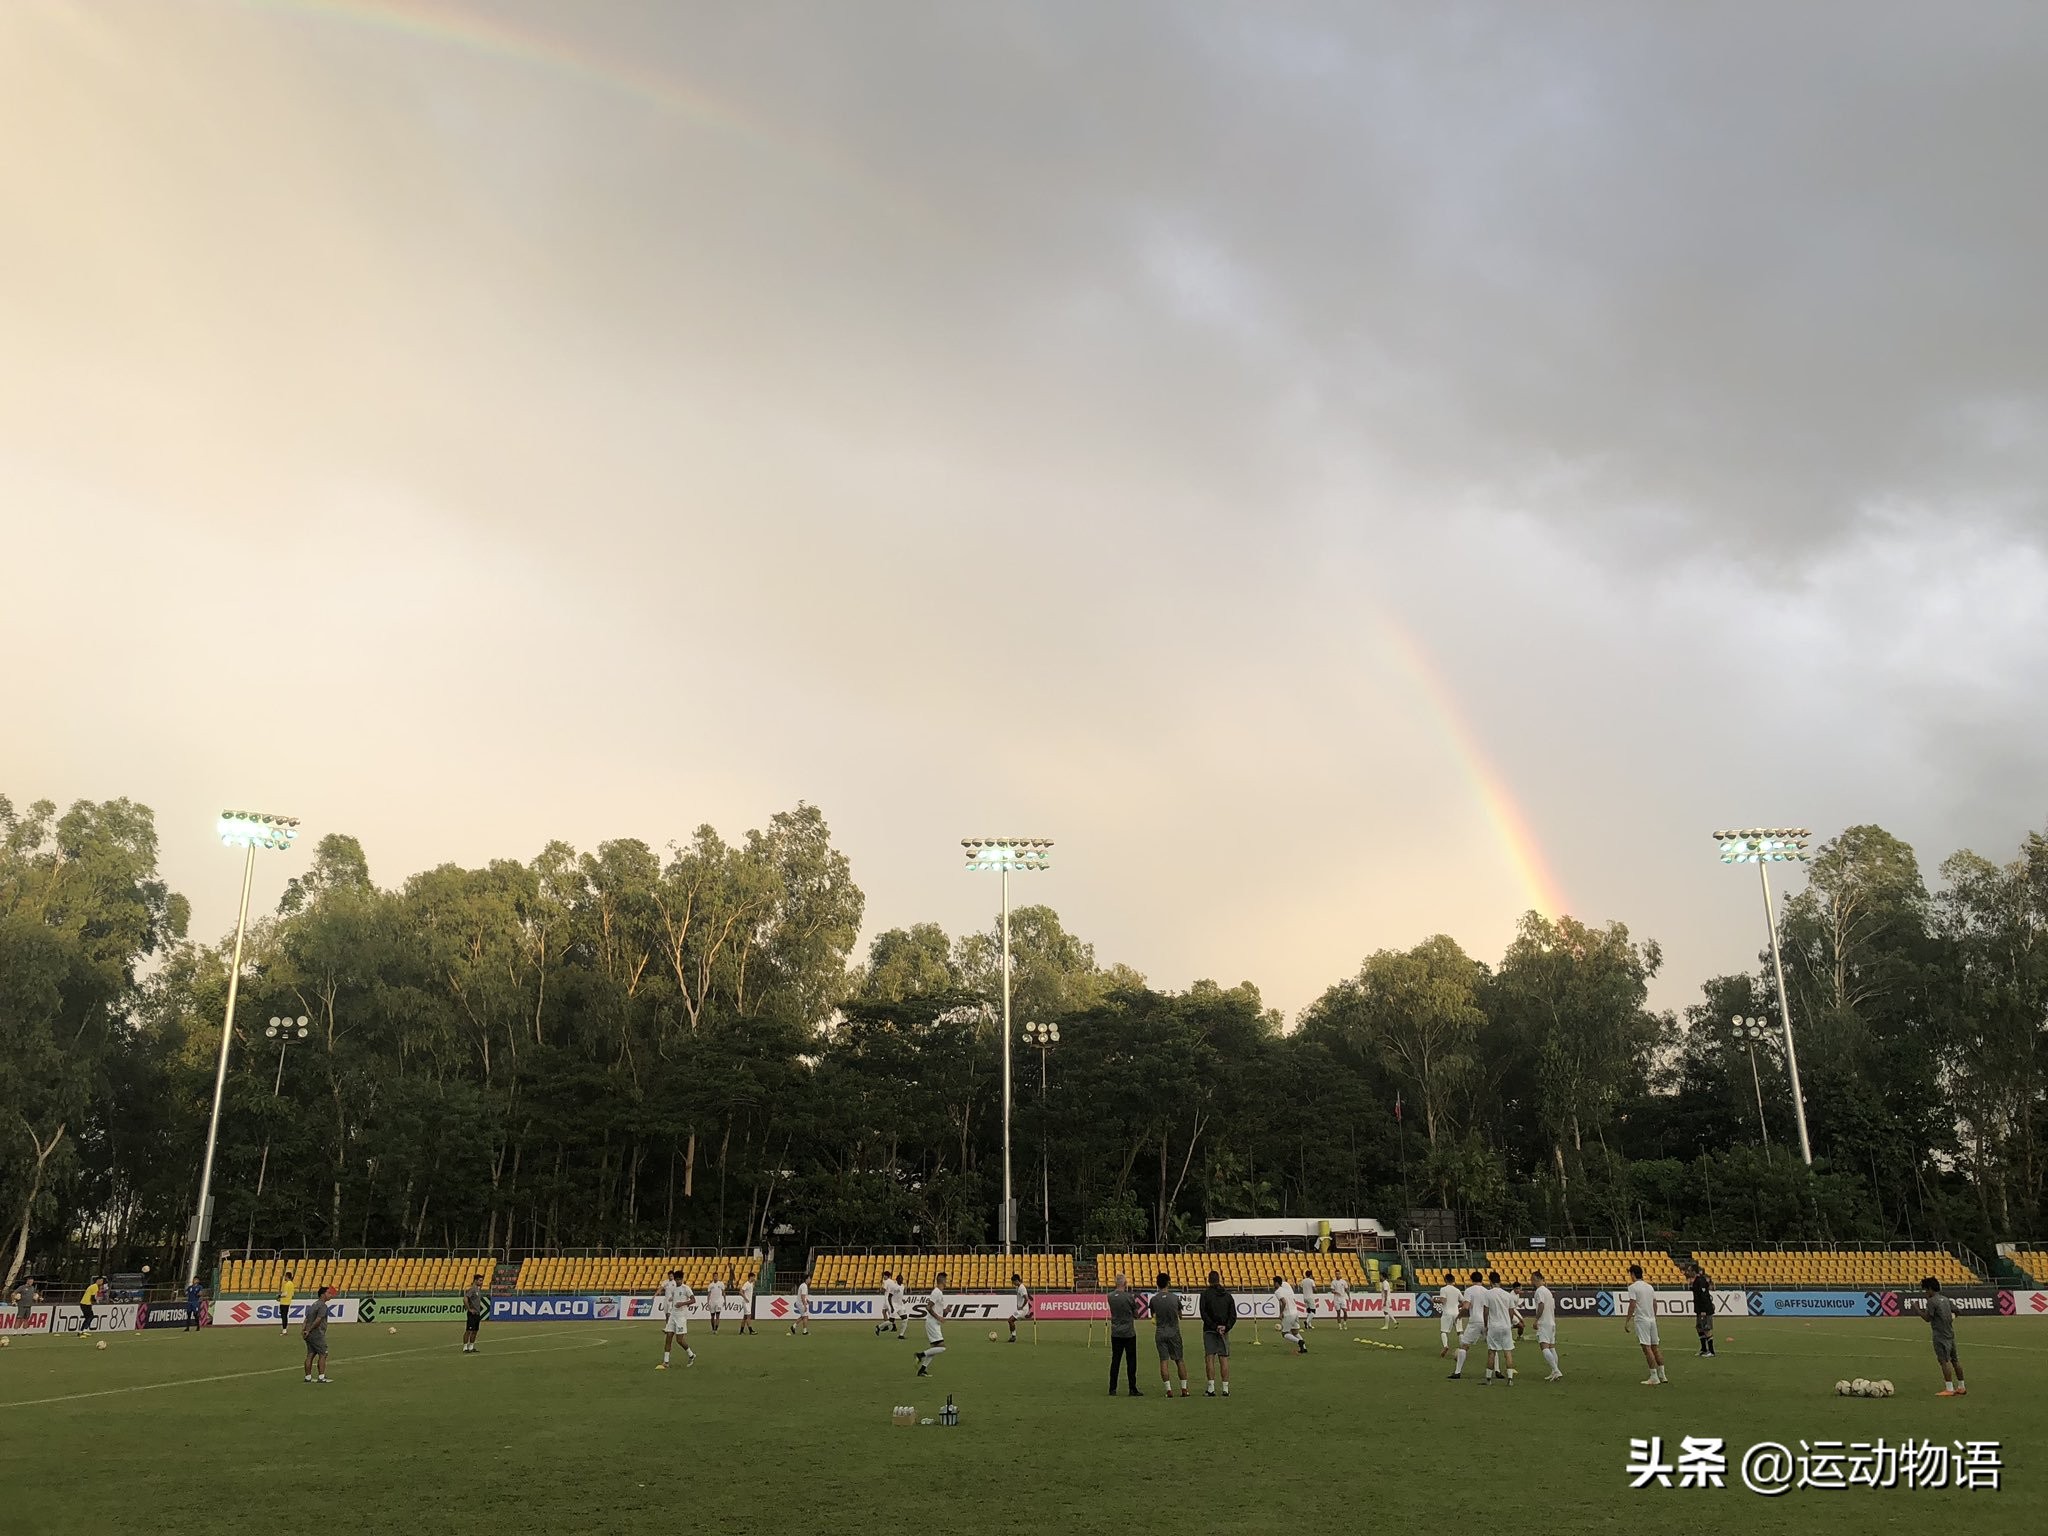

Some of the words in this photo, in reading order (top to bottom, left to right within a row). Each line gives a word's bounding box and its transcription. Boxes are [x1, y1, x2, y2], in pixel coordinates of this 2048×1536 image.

[493, 1300, 589, 1316] PINACO
[1040, 1301, 1110, 1312] #AFFSUZUKICU
[1560, 1297, 1597, 1310] CUP
[1775, 1299, 1855, 1310] @AFFSUZUKICUP
[909, 1304, 999, 1318] SIFT
[109, 1306, 129, 1330] 8X
